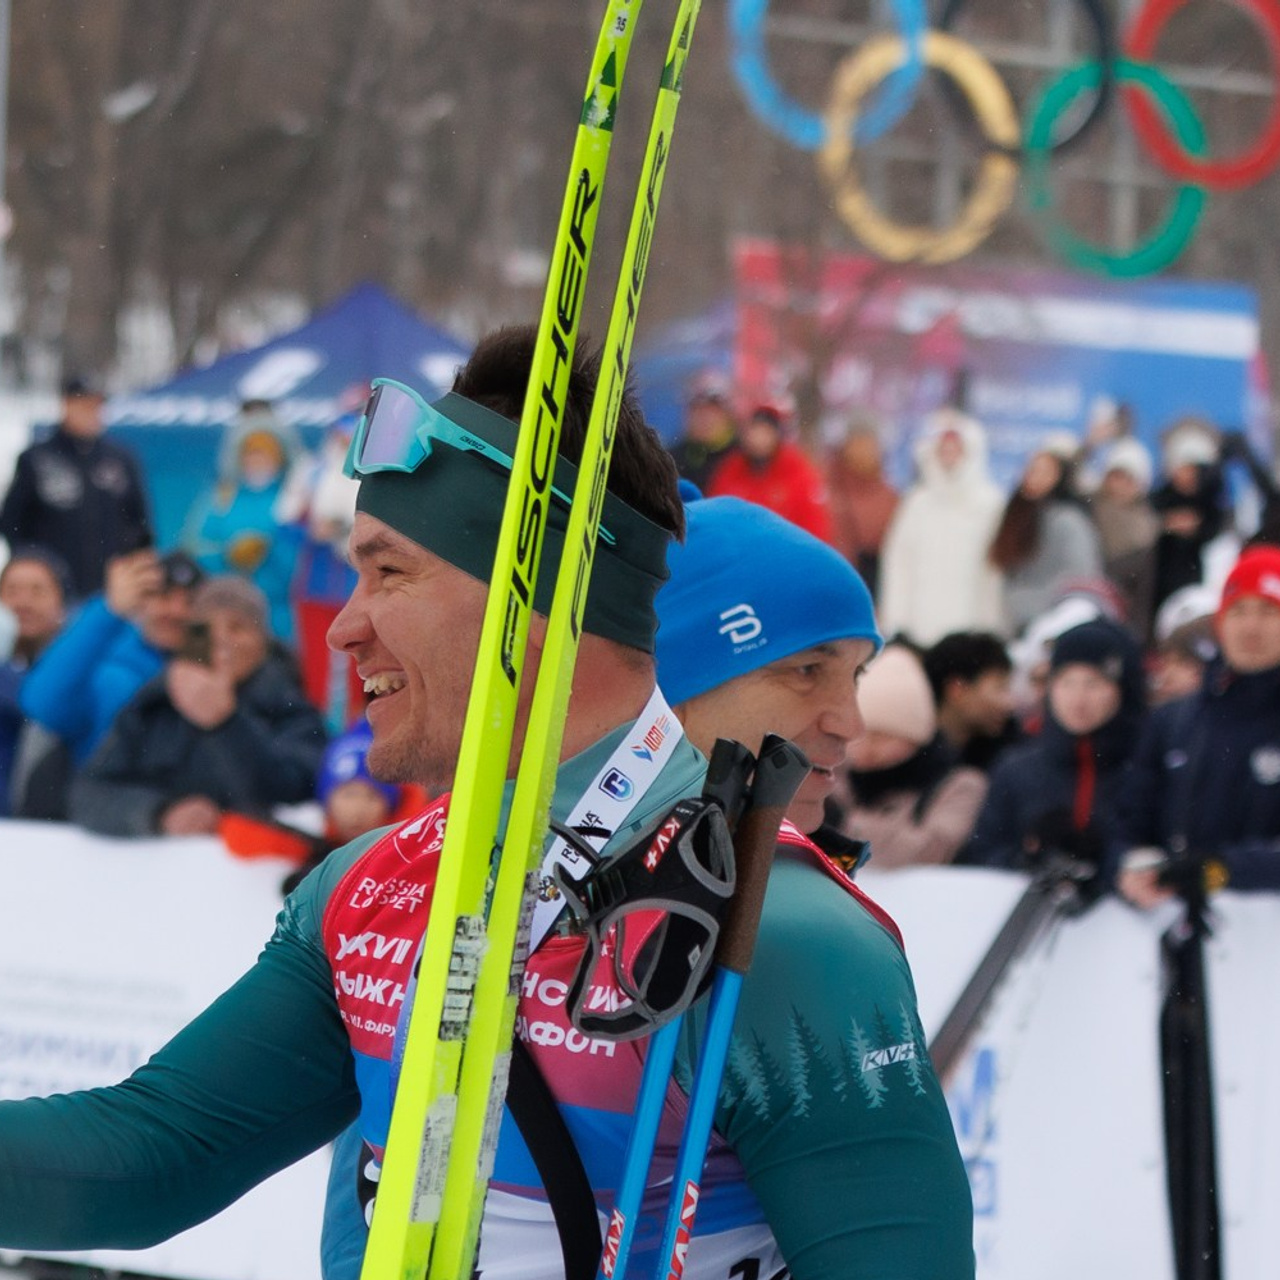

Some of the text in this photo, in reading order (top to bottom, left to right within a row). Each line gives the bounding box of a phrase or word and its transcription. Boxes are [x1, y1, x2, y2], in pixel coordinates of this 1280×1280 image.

[501, 167, 599, 689] FISCHER
[570, 130, 667, 645] FISCHER
[647, 817, 681, 869] KV+
[602, 1208, 625, 1278] KV+
